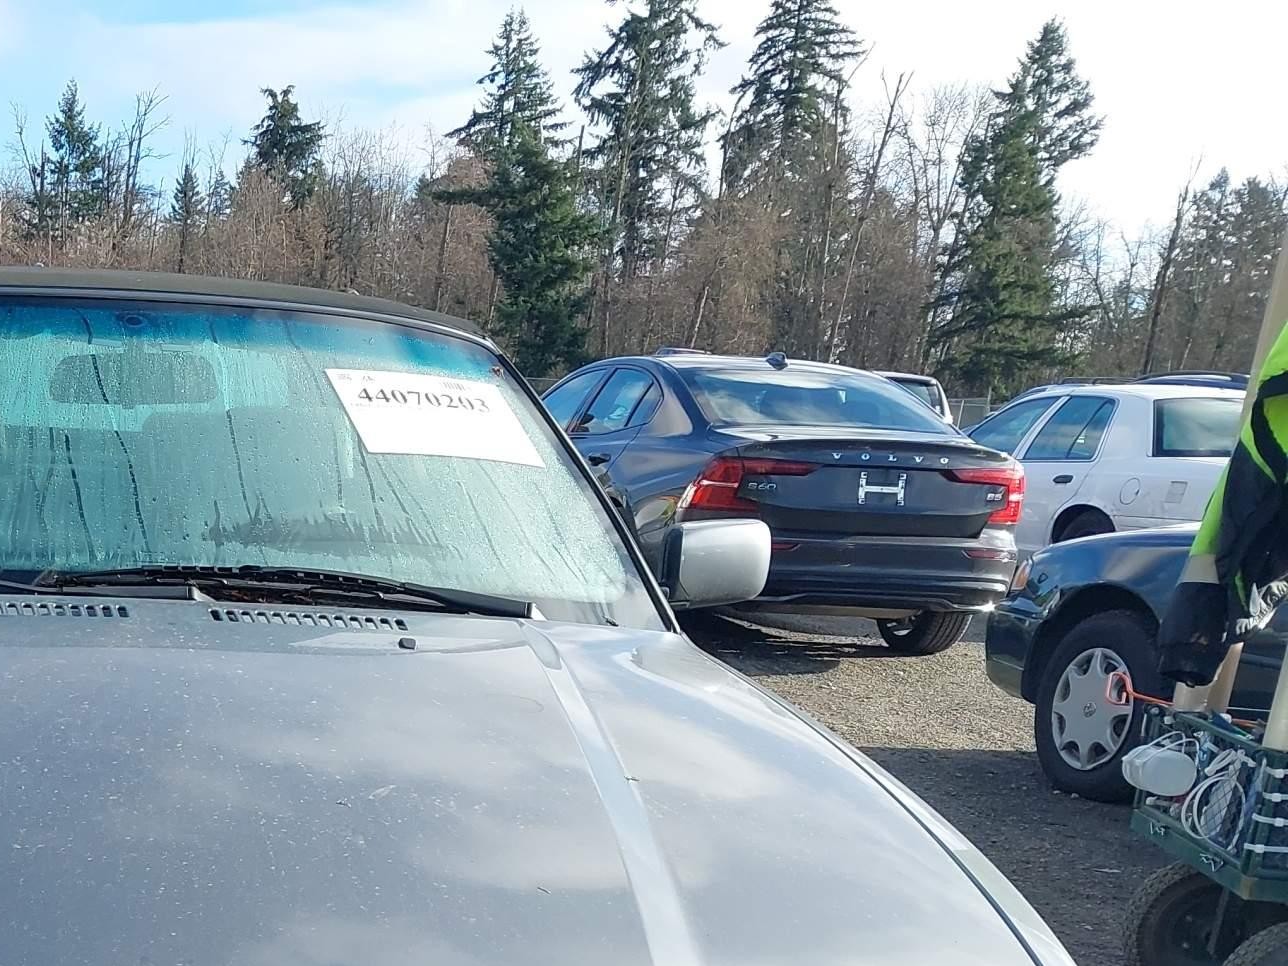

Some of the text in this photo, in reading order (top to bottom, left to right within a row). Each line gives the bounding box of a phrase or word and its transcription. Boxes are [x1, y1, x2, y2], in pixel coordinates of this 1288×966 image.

[357, 387, 490, 413] 44070203
[831, 452, 950, 465] VOLVO
[747, 482, 777, 491] S60
